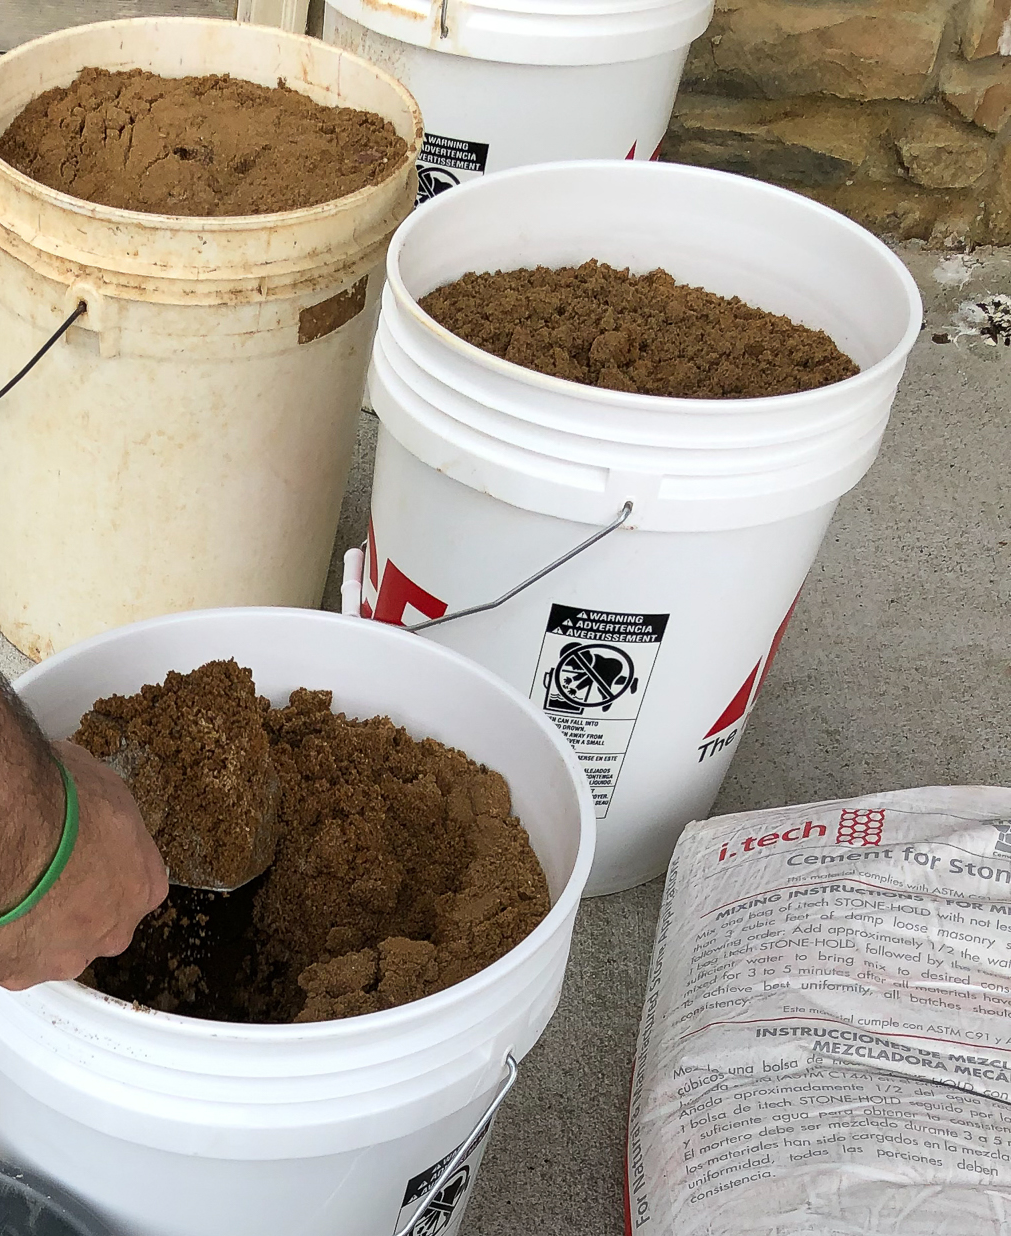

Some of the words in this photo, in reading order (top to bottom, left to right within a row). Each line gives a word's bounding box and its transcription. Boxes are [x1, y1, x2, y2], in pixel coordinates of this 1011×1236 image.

[428, 135, 469, 151] WARNING
[418, 153, 481, 171] VERTISSEMENT
[575, 620, 653, 633] ADVERTENCIA
[589, 611, 644, 623] WARNING
[566, 628, 658, 642] AVERTISSEMENT
[698, 728, 738, 763] The
[719, 821, 827, 862] i.tech
[787, 848, 893, 866] Cement
[902, 846, 942, 870] for
[858, 870, 904, 888] complies
[906, 883, 929, 893] with
[932, 887, 966, 899] ASTM
[715, 894, 782, 921] MIXING
[789, 884, 925, 902] INSTRUCTIONS
[946, 900, 985, 911] FOR
[748, 908, 774, 920] bag
[778, 902, 793, 914] of
[834, 898, 932, 917] STONE-HOLD
[937, 912, 965, 925] with
[970, 918, 991, 929] not
[690, 938, 742, 966] following
[791, 923, 823, 935] Add
[827, 925, 924, 949] approximately
[961, 948, 981, 963] the
[741, 917, 777, 932] cubic
[820, 910, 835, 921] of
[844, 912, 884, 928] damp
[893, 916, 929, 934] loose
[937, 928, 997, 949] masonry
[686, 960, 736, 988] sufficient
[746, 953, 784, 965] water
[795, 953, 808, 961] to
[818, 951, 855, 967] bring
[864, 960, 887, 972] mix
[897, 966, 910, 977] to
[920, 969, 971, 986] desired
[865, 943, 922, 963] followed
[927, 954, 945, 969] by
[682, 975, 718, 999] mixed
[722, 970, 742, 982] for
[747, 967, 757, 978] 3
[763, 967, 776, 977] to
[782, 964, 792, 974] 5
[798, 965, 851, 978] minutes
[914, 985, 977, 1000] materials
[702, 984, 754, 1000] achieve
[801, 979, 874, 997] uniformity,
[883, 989, 901, 1000] all
[909, 993, 963, 1011] batches
[680, 997, 752, 1022] consistency.
[755, 1026, 912, 1052] INSTRUCCIONES
[857, 1017, 900, 1029] cumple
[902, 1022, 924, 1031] con
[927, 1024, 962, 1037] ASTM
[965, 1031, 990, 1041] C91
[728, 1065, 755, 1075] una
[762, 1058, 799, 1074] bolsa
[806, 1053, 824, 1065] de
[812, 1040, 948, 1072] MEZCLADORA
[677, 1072, 726, 1097] cúbicos
[678, 1097, 723, 1120] Añada
[733, 1082, 865, 1101] aproximadamente
[875, 1084, 904, 1095] 1/2
[914, 1087, 935, 1097] del
[683, 1139, 691, 1150] y
[699, 1116, 762, 1140] suficiente
[772, 1111, 809, 1124] agua
[863, 1106, 917, 1118] obtener
[690, 1112, 727, 1129] bolsa
[733, 1103, 751, 1115] de
[799, 1095, 902, 1106] STONE-HOLD
[909, 1101, 964, 1114] seguido
[970, 1110, 994, 1120] por
[683, 1148, 695, 1162] El
[699, 1132, 753, 1155] mortero
[758, 1125, 795, 1137] debe
[801, 1123, 822, 1132] ser
[828, 1118, 899, 1130] mezclado
[904, 1121, 959, 1138] durante
[963, 1130, 974, 1141] 3
[978, 1135, 988, 1144] a
[992, 1136, 1003, 1146] 5
[685, 1163, 704, 1176] los
[707, 1141, 779, 1167] materiales
[783, 1137, 811, 1147] han
[816, 1133, 847, 1145] sido
[852, 1133, 920, 1146] cargados
[923, 1140, 941, 1150] en
[944, 1140, 958, 1153] la
[631, 1122, 646, 1195] Natural
[688, 1153, 776, 1190] uniformidad,
[789, 1149, 830, 1162] todas
[842, 1144, 864, 1154] las
[877, 1148, 944, 1167] porciones
[957, 1158, 999, 1177] deben
[690, 1170, 777, 1204] consistencia.
[635, 1194, 650, 1230] For
